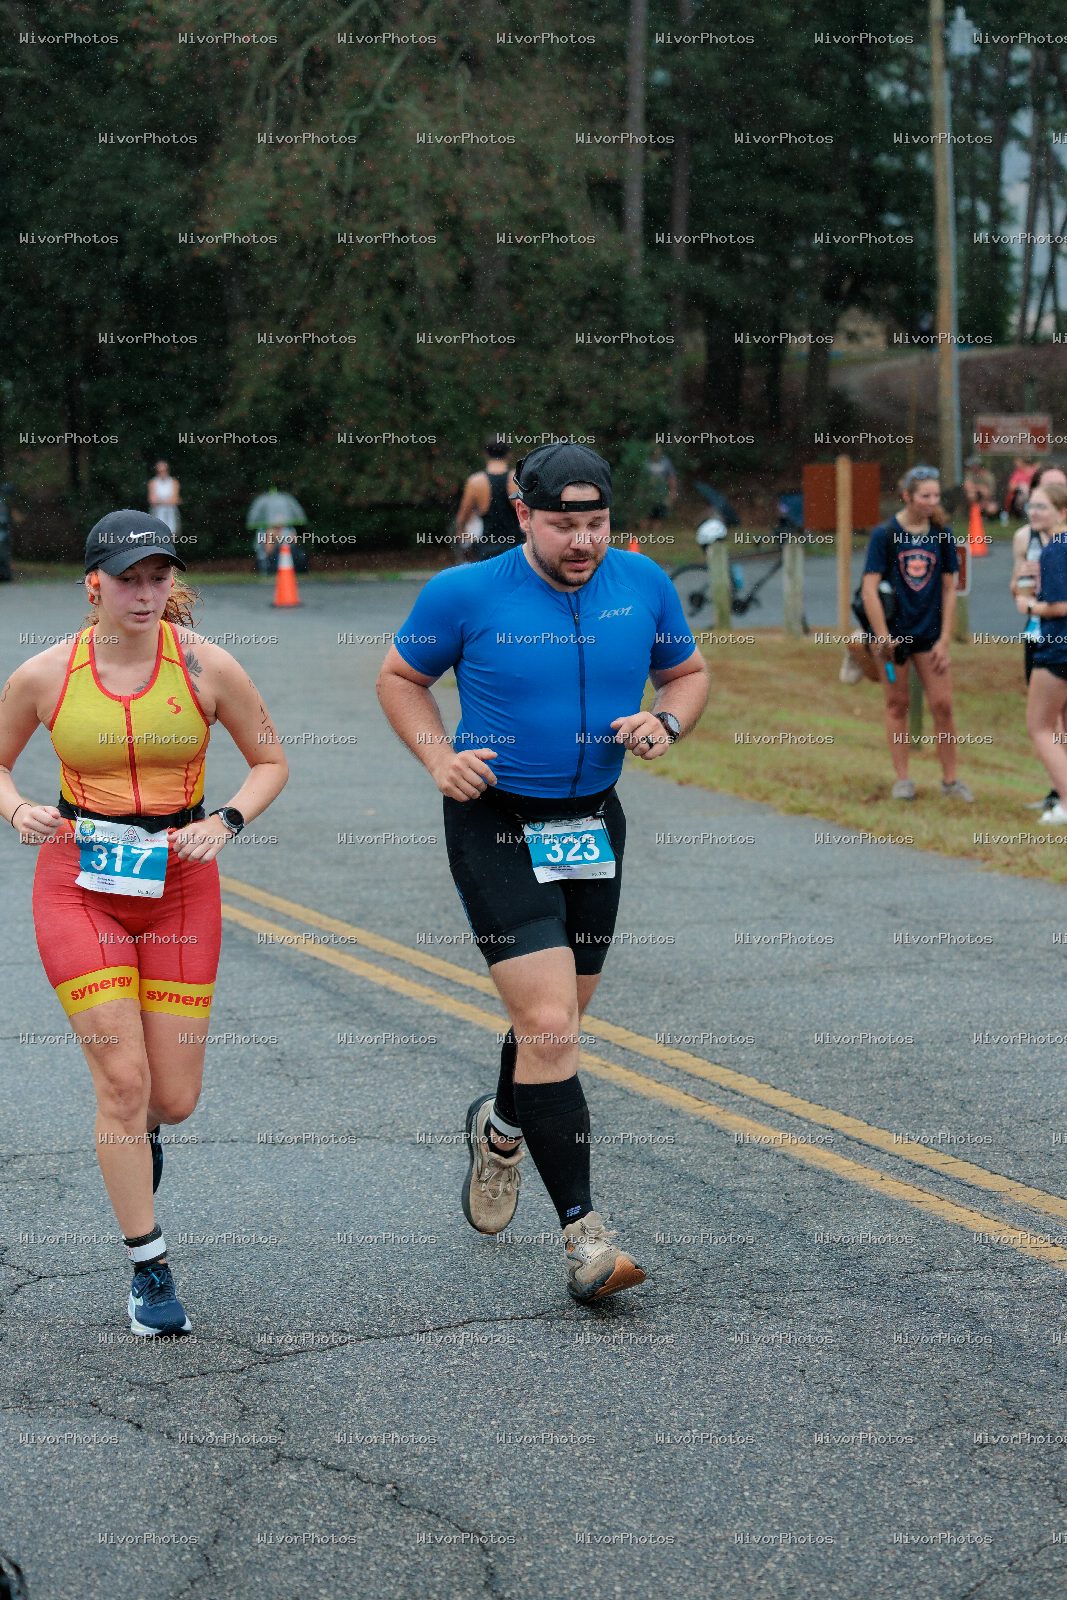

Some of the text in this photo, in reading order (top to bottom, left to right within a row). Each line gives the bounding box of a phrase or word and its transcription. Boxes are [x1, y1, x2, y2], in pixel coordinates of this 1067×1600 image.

[91, 844, 153, 875] 317
[544, 833, 600, 863] 323
[70, 975, 133, 1001] synergy
[145, 988, 213, 1008] synerg
